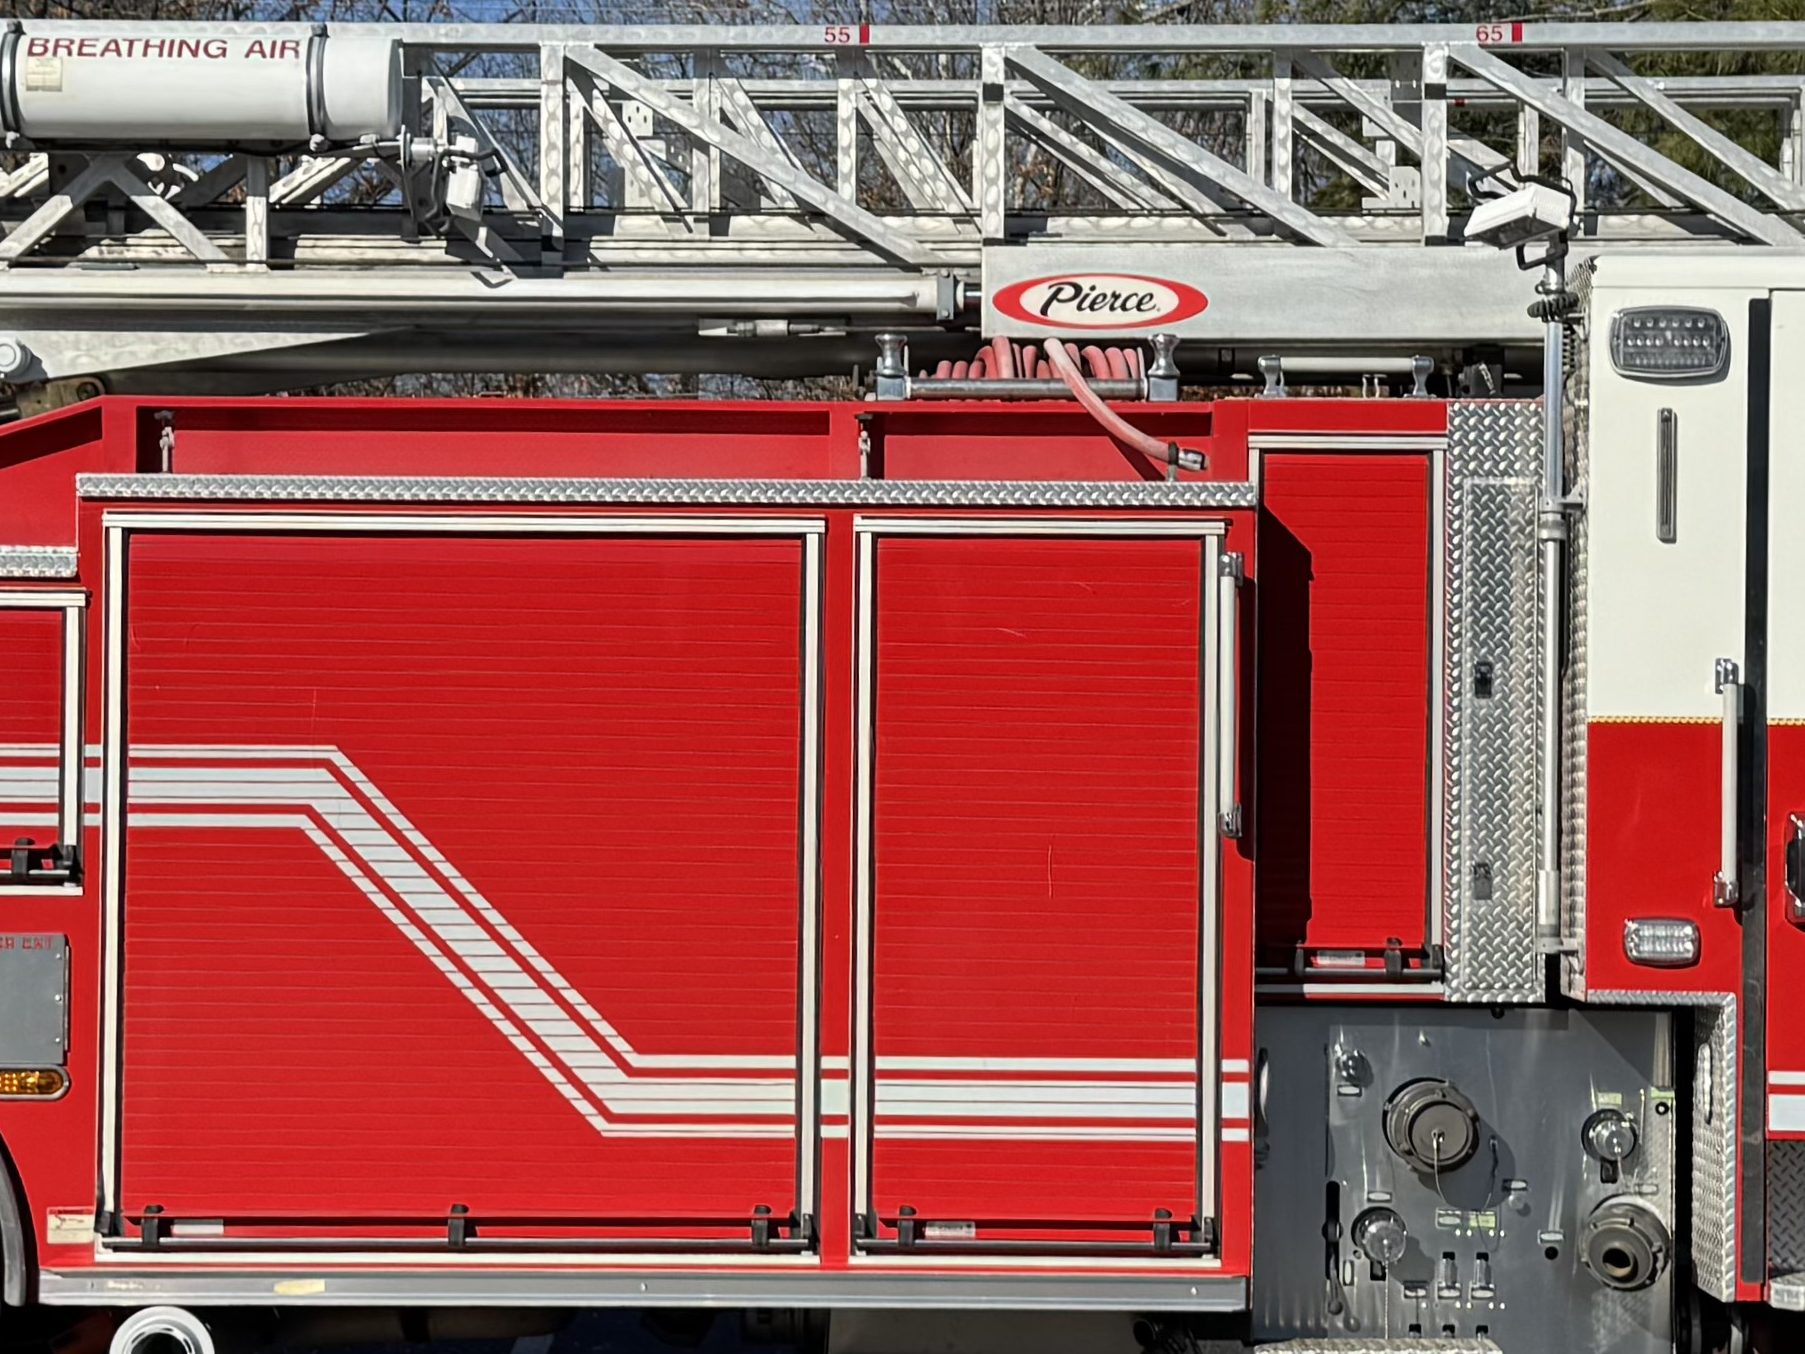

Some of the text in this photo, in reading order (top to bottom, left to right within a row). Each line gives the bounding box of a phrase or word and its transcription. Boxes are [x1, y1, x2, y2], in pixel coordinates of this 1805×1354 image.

[824, 26, 851, 43] 55
[1476, 24, 1503, 42] 65
[26, 37, 301, 59] BREATHING AIR
[1039, 281, 1157, 317] Pierce
